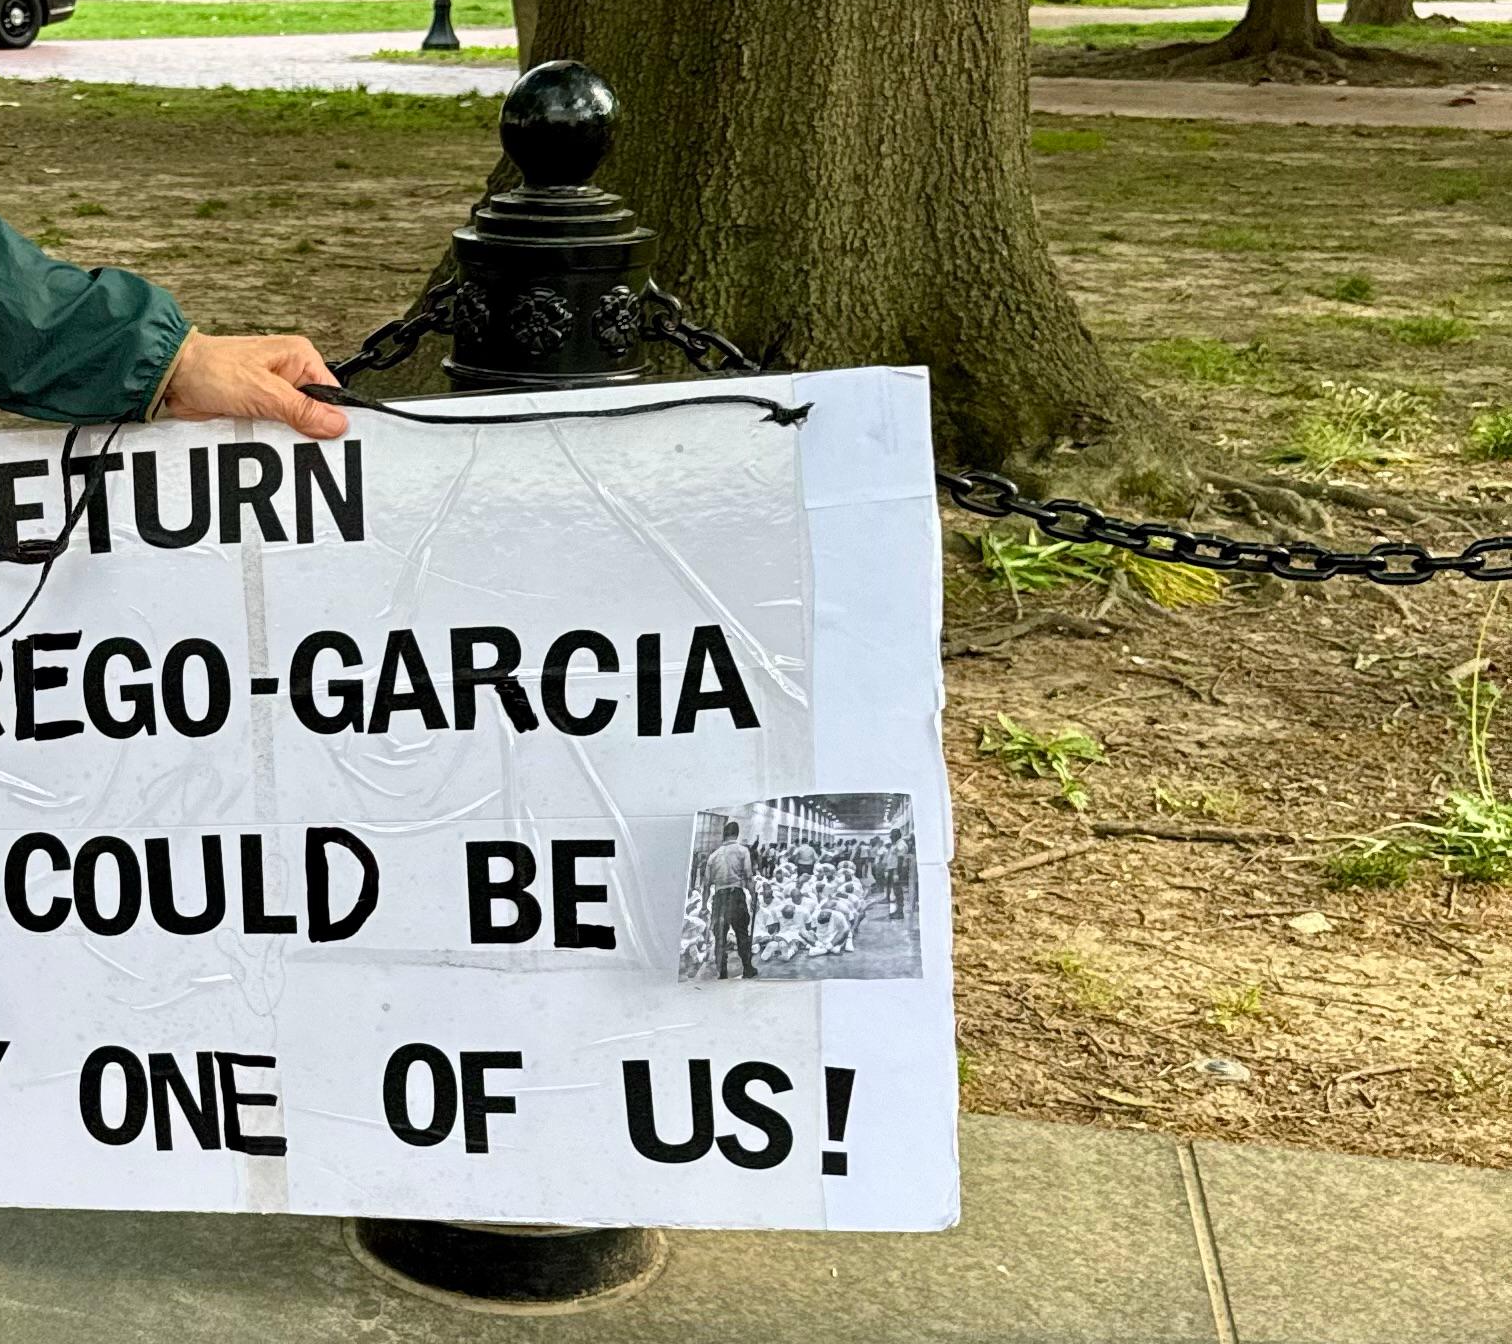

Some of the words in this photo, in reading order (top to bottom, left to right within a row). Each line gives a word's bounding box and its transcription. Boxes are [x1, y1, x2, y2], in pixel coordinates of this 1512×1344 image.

[4, 826, 380, 943] COULD
[465, 839, 617, 950] BE
[79, 1045, 288, 1157] ONE
[382, 1042, 524, 1154] OF
[622, 1058, 857, 1177] US!
